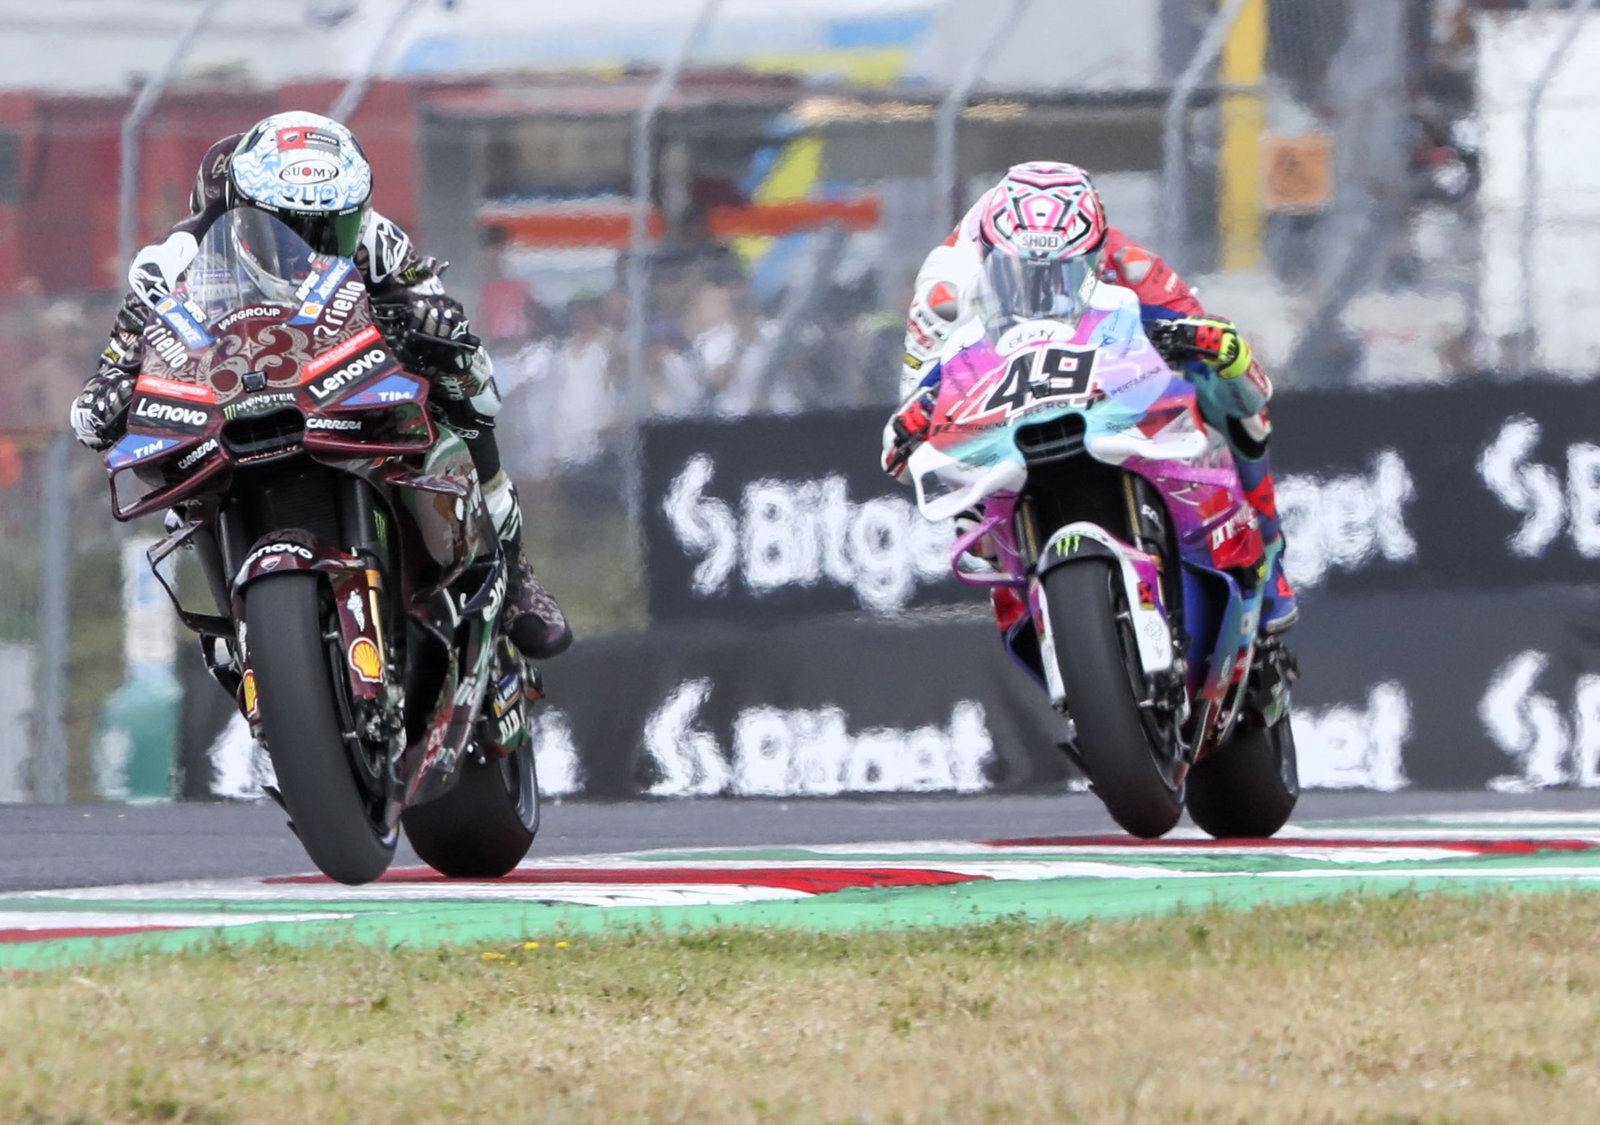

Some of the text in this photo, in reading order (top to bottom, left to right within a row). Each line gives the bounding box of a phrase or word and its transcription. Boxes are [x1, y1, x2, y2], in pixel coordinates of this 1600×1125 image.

[306, 132, 338, 145] Lenovo
[284, 166, 335, 179] SUOMY
[1022, 236, 1059, 248] SHOEI
[218, 307, 281, 331] VARGROUP
[309, 349, 386, 399] Lenovo
[984, 349, 1096, 412] 49
[236, 392, 296, 412] MONSTER
[379, 391, 410, 402] TIM
[136, 397, 208, 426] Lenovo
[306, 418, 362, 430] CARRERA
[133, 440, 163, 459] TIM
[178, 438, 219, 470] CARRERA
[244, 543, 314, 566] enovo
